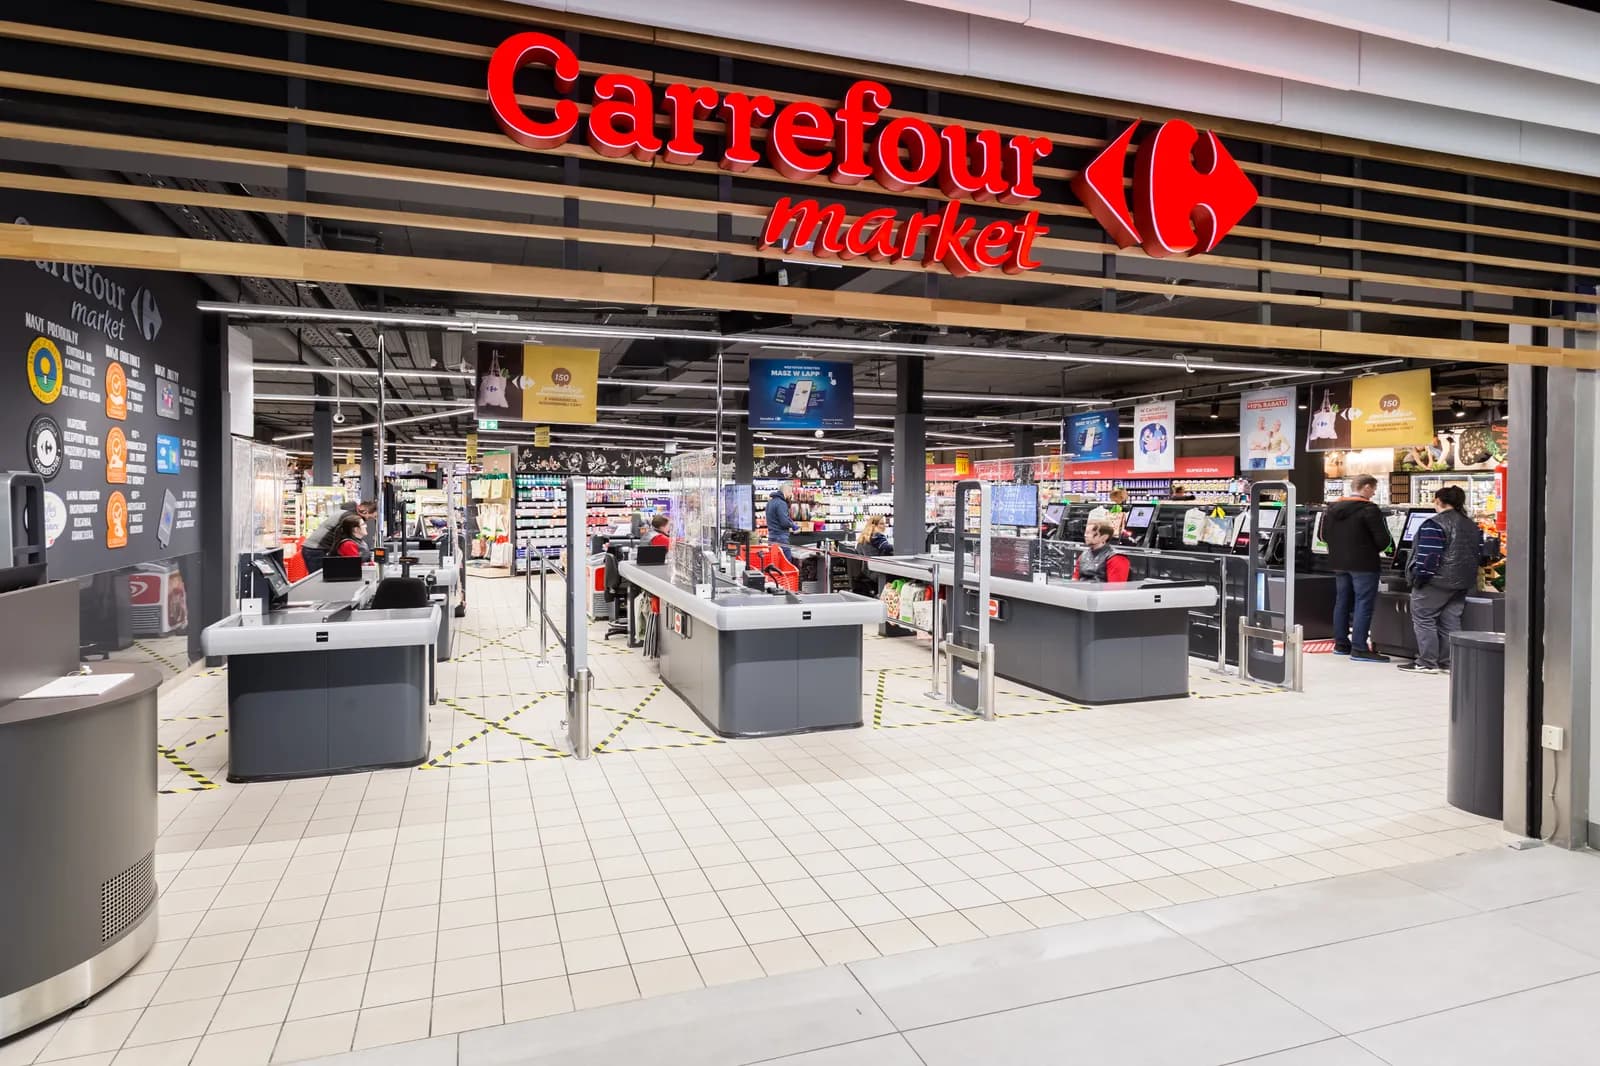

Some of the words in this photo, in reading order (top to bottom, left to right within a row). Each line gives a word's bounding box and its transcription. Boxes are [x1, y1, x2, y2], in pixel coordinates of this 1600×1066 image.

[486, 32, 1052, 200] Carrefour
[758, 195, 1050, 277] market
[71, 300, 127, 341] market
[555, 373, 570, 382] 150
[1383, 399, 1398, 408] 150
